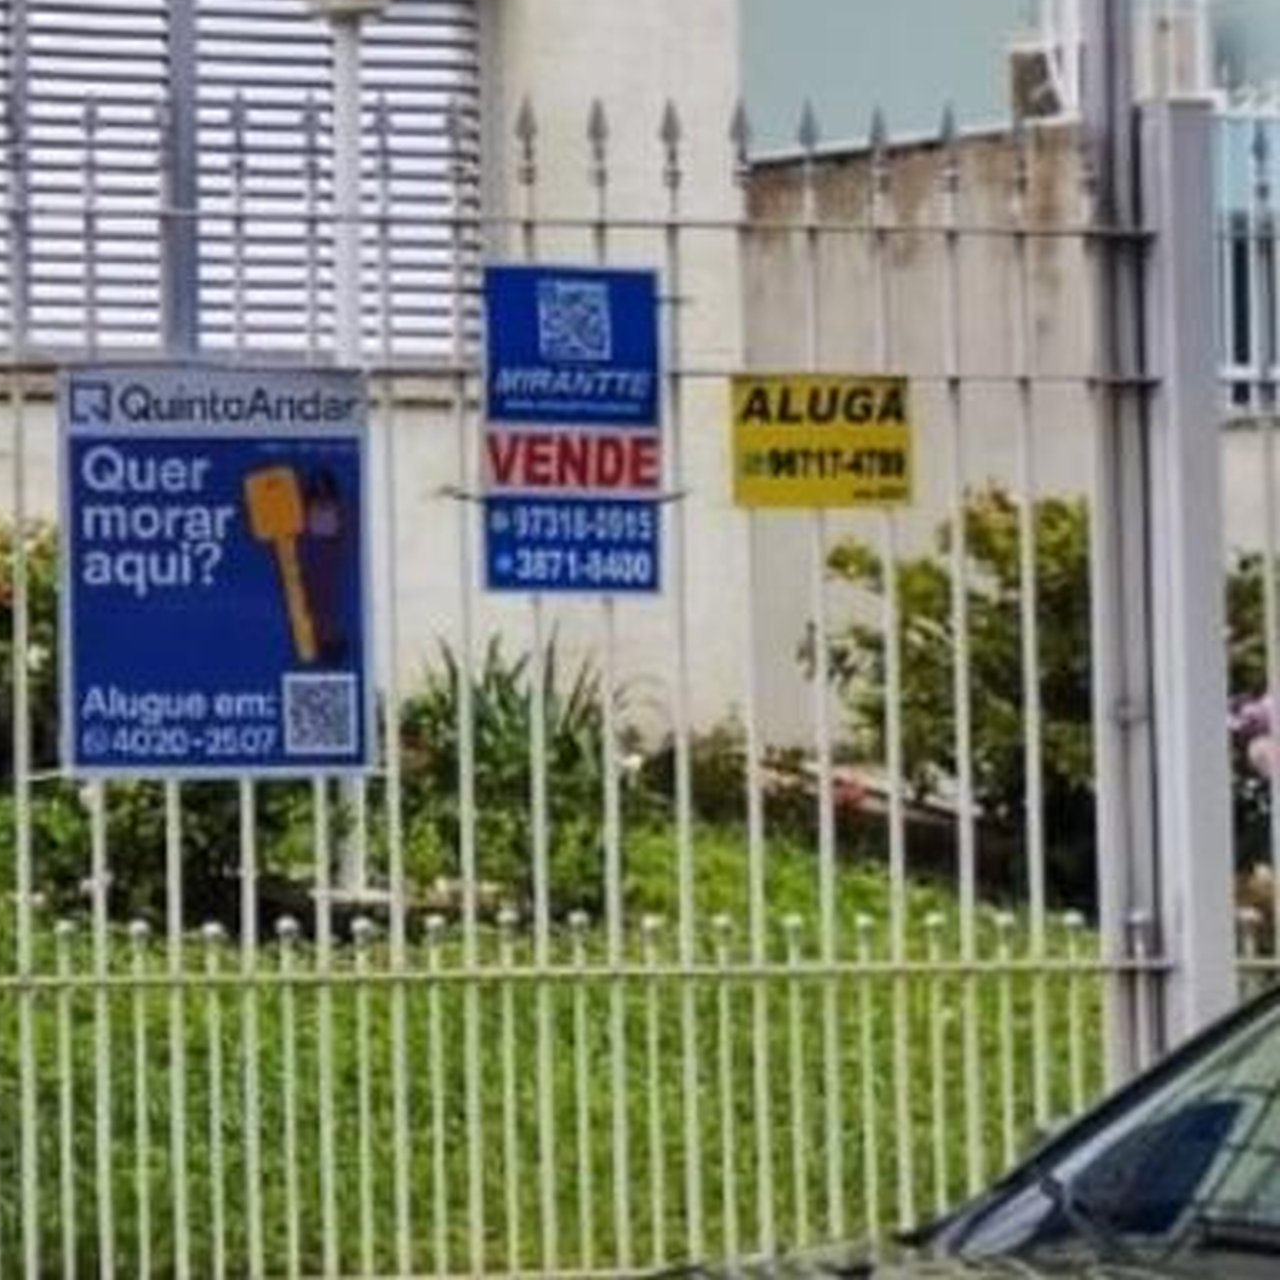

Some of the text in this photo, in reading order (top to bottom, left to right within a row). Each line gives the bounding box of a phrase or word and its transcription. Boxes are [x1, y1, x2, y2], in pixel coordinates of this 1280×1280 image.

[495, 367, 652, 399] MIRANTTE
[118, 384, 355, 422] QuintoAndar
[742, 386, 906, 424] ALUGA
[81, 445, 211, 493] Quer
[487, 431, 660, 489] VENDE
[81, 504, 235, 540] morar
[81, 541, 223, 597] aqui?
[81, 685, 276, 725] Alugue em:
